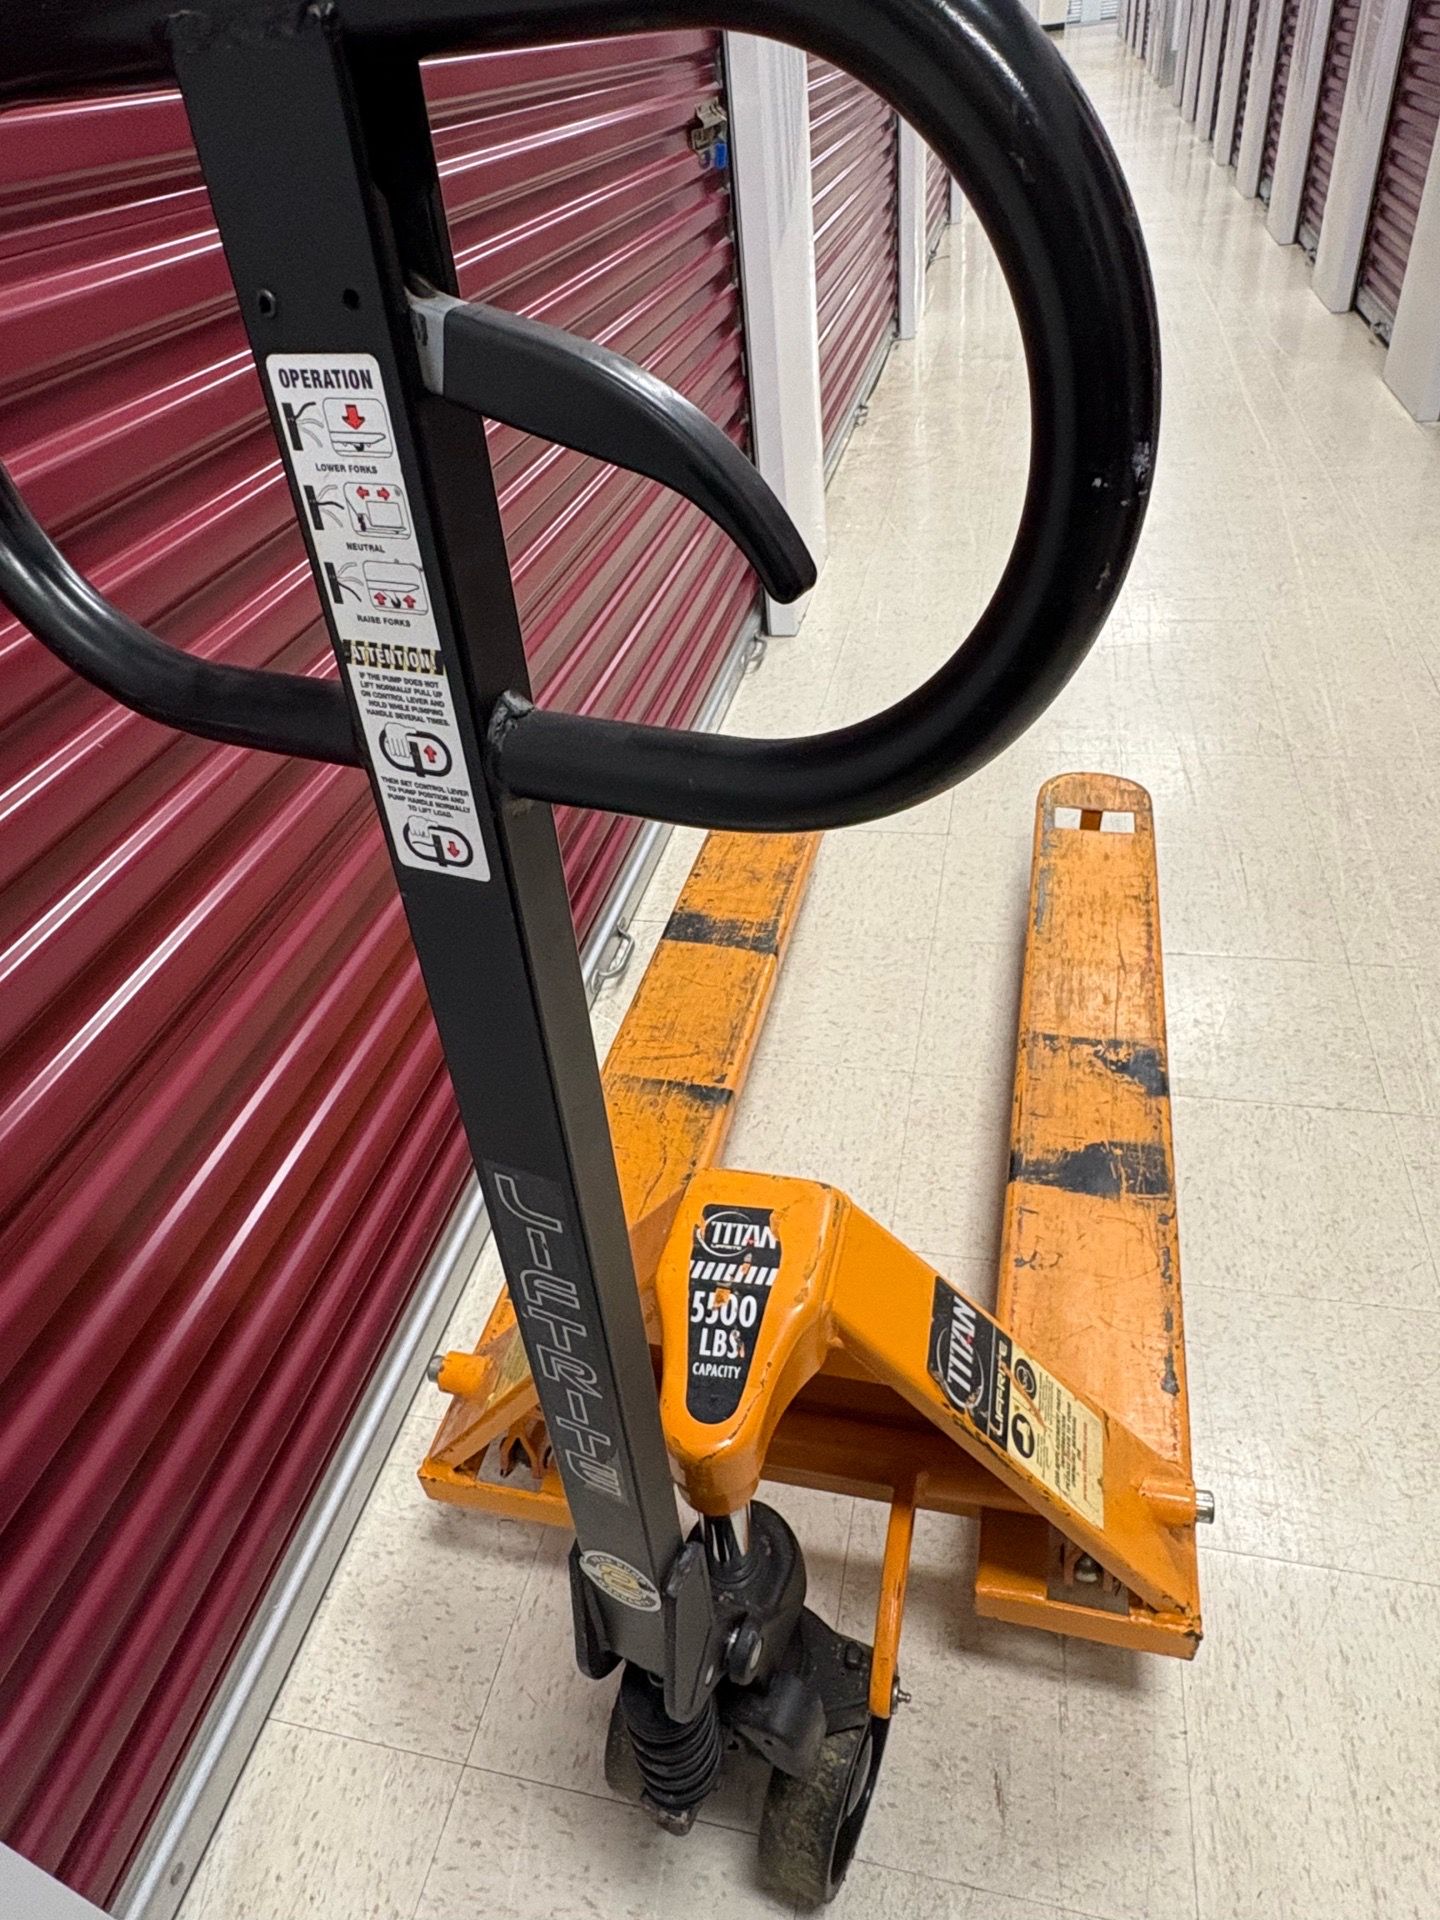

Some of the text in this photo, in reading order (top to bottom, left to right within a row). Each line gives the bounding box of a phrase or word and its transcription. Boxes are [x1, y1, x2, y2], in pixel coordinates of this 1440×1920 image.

[278, 368, 373, 389] OPERATION
[315, 463, 378, 474] LOWER FORKS
[346, 542, 386, 553] NEUTRAL
[356, 614, 411, 627] RAISE FORKS
[350, 645, 437, 670] ATTENTION!
[367, 672, 380, 680] THE
[404, 678, 422, 686] DOES
[376, 682, 411, 693] NORMALLY
[414, 688, 431, 697] PULL
[373, 692, 405, 702] CONTROL
[407, 696, 428, 705] LEVER
[430, 699, 445, 707] AND
[366, 709, 393, 718] HANDLE
[395, 712, 425, 722] SEVERAL
[369, 700, 387, 708] HOLD
[412, 705, 443, 716] PUMPING
[381, 776, 398, 784] THEN
[414, 781, 445, 792] CONTROL
[447, 786, 469, 796] LEVER
[388, 794, 470, 813] PUMP HANDLE NORMALLY
[398, 788, 416, 796] PUMP
[418, 790, 448, 801] POSITION
[450, 796, 465, 804] AND
[419, 806, 431, 814] LIFT
[711, 1221, 777, 1249] TITAN
[946, 1295, 977, 1393] TITAN
[692, 1362, 741, 1379] CAPACITY
